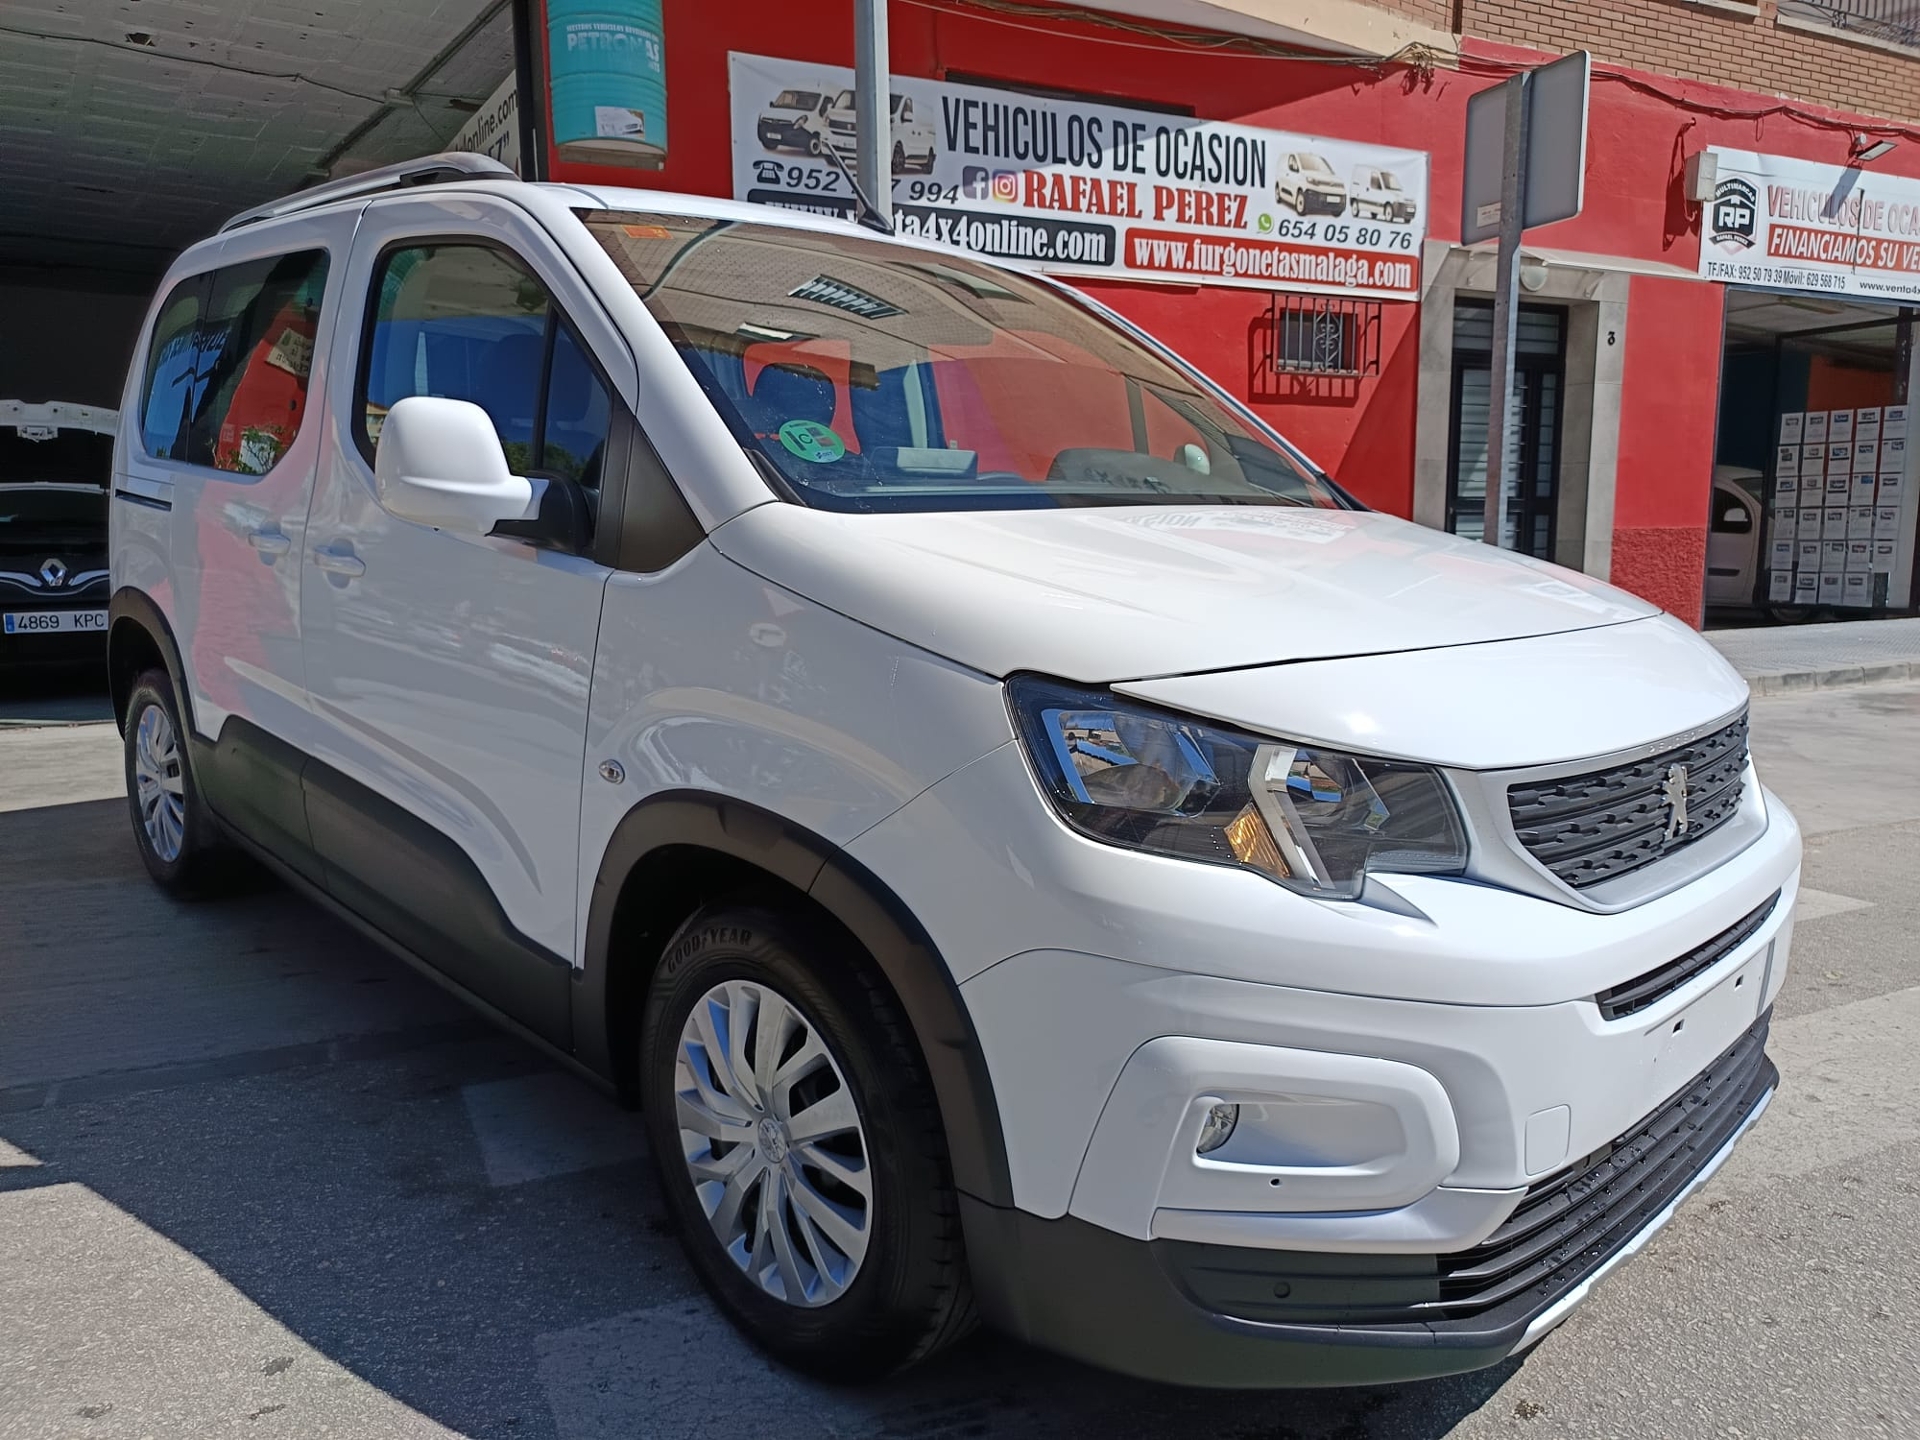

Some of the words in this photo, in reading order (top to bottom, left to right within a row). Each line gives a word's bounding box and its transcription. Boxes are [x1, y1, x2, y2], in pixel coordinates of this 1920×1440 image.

[942, 96, 1103, 169] VEHICULOS
[1113, 120, 1146, 175] DE
[1155, 125, 1266, 189] OCASION
[786, 166, 841, 193] 952
[909, 180, 959, 205] 994
[1023, 169, 1143, 219] RAFAEL
[1153, 184, 1249, 230] PEREZ
[1715, 182, 1756, 202] MULTIMARCAS
[1718, 205, 1751, 229] RP
[1767, 184, 1860, 228] VEHICULOS
[1862, 199, 1886, 232] DE
[1887, 203, 1920, 237] OCA
[1278, 218, 1318, 241] 654
[1323, 223, 1350, 244] 05
[1356, 227, 1381, 248] 80
[1388, 230, 1413, 250] 76
[1770, 227, 1877, 267] FINANCIAMOS
[1877, 241, 1900, 269] SU
[1902, 243, 1920, 271] VE
[1133, 236, 1412, 289] www.furgonetasmalaga.com
[18, 615, 60, 630] 4869
[74, 613, 105, 629] KPC
